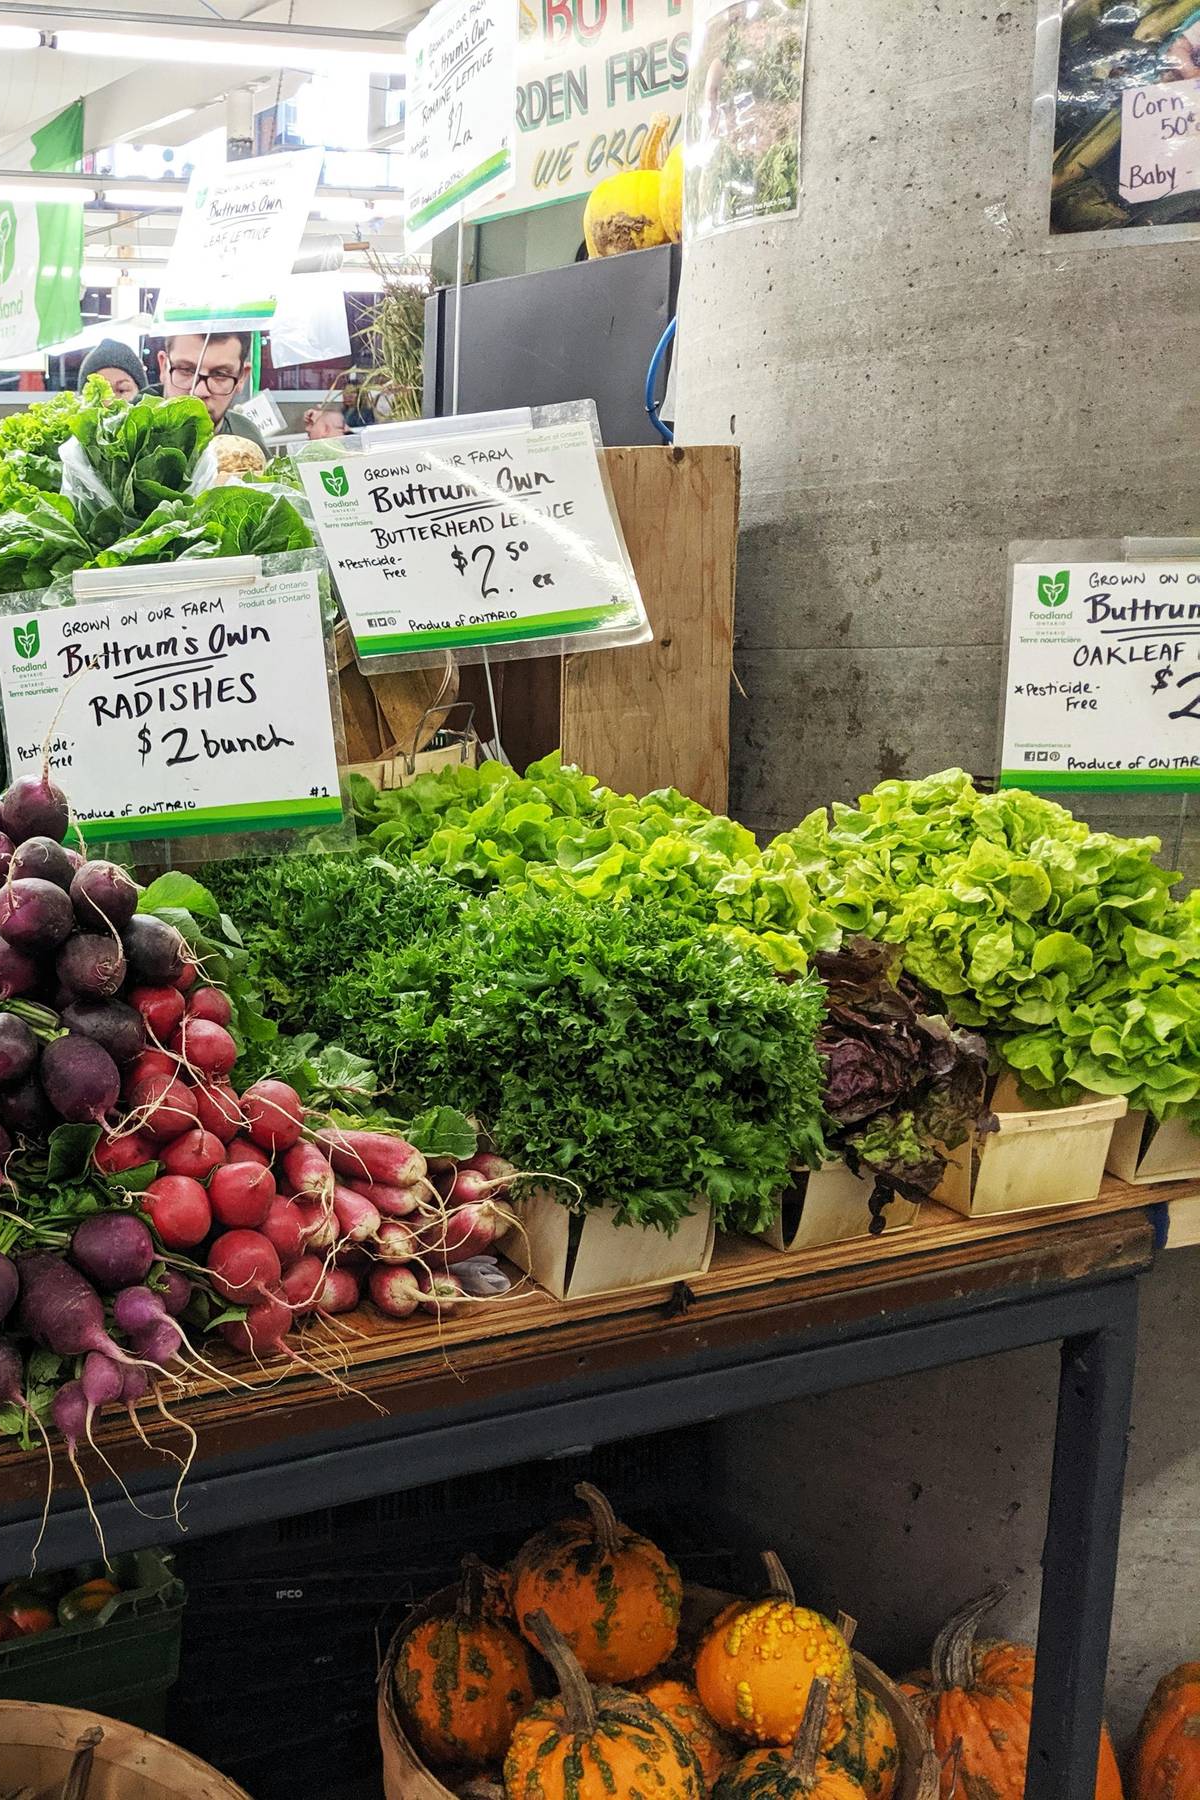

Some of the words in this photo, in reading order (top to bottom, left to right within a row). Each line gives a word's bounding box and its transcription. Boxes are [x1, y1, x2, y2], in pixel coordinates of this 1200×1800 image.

[1133, 91, 1184, 119] Corn
[534, 141, 579, 190] WE
[1129, 163, 1176, 190] Baby
[258, 194, 283, 213] Own
[364, 465, 410, 482] GROWN
[416, 461, 432, 473] ON
[467, 447, 514, 464] FARM
[497, 466, 555, 493] Own
[324, 499, 359, 509] Foodland
[371, 516, 494, 549] BUTTERHEAD
[383, 568, 407, 580] Free
[1089, 572, 1146, 588] GROWN
[1160, 574, 1179, 584] ON
[238, 586, 268, 596] Product
[270, 584, 278, 592] of
[279, 581, 309, 591] Ontario
[238, 600, 265, 609] Produit
[62, 616, 111, 638] GROWN
[121, 612, 138, 626] ON
[148, 606, 175, 622] OUR
[182, 598, 225, 616] FARM
[408, 617, 450, 632] Produce
[455, 613, 467, 629] of
[470, 610, 518, 624] ONTARIO
[1029, 611, 1073, 620] Foodland
[208, 623, 270, 653] Own
[1019, 635, 1038, 643] Terre
[12, 660, 48, 673] Foodland
[20, 681, 44, 689] ONTARIO
[8, 690, 23, 698] Terre
[88, 672, 258, 727] RADISHES
[1066, 697, 1098, 712] Free
[201, 724, 295, 762] bunch
[49, 755, 72, 769] Free
[1068, 756, 1123, 770] Produce
[1128, 755, 1146, 769] of
[309, 786, 330, 798] #1
[120, 803, 133, 817] of
[139, 800, 196, 816] ONTARIO
[276, 1590, 303, 1599] IFCO
